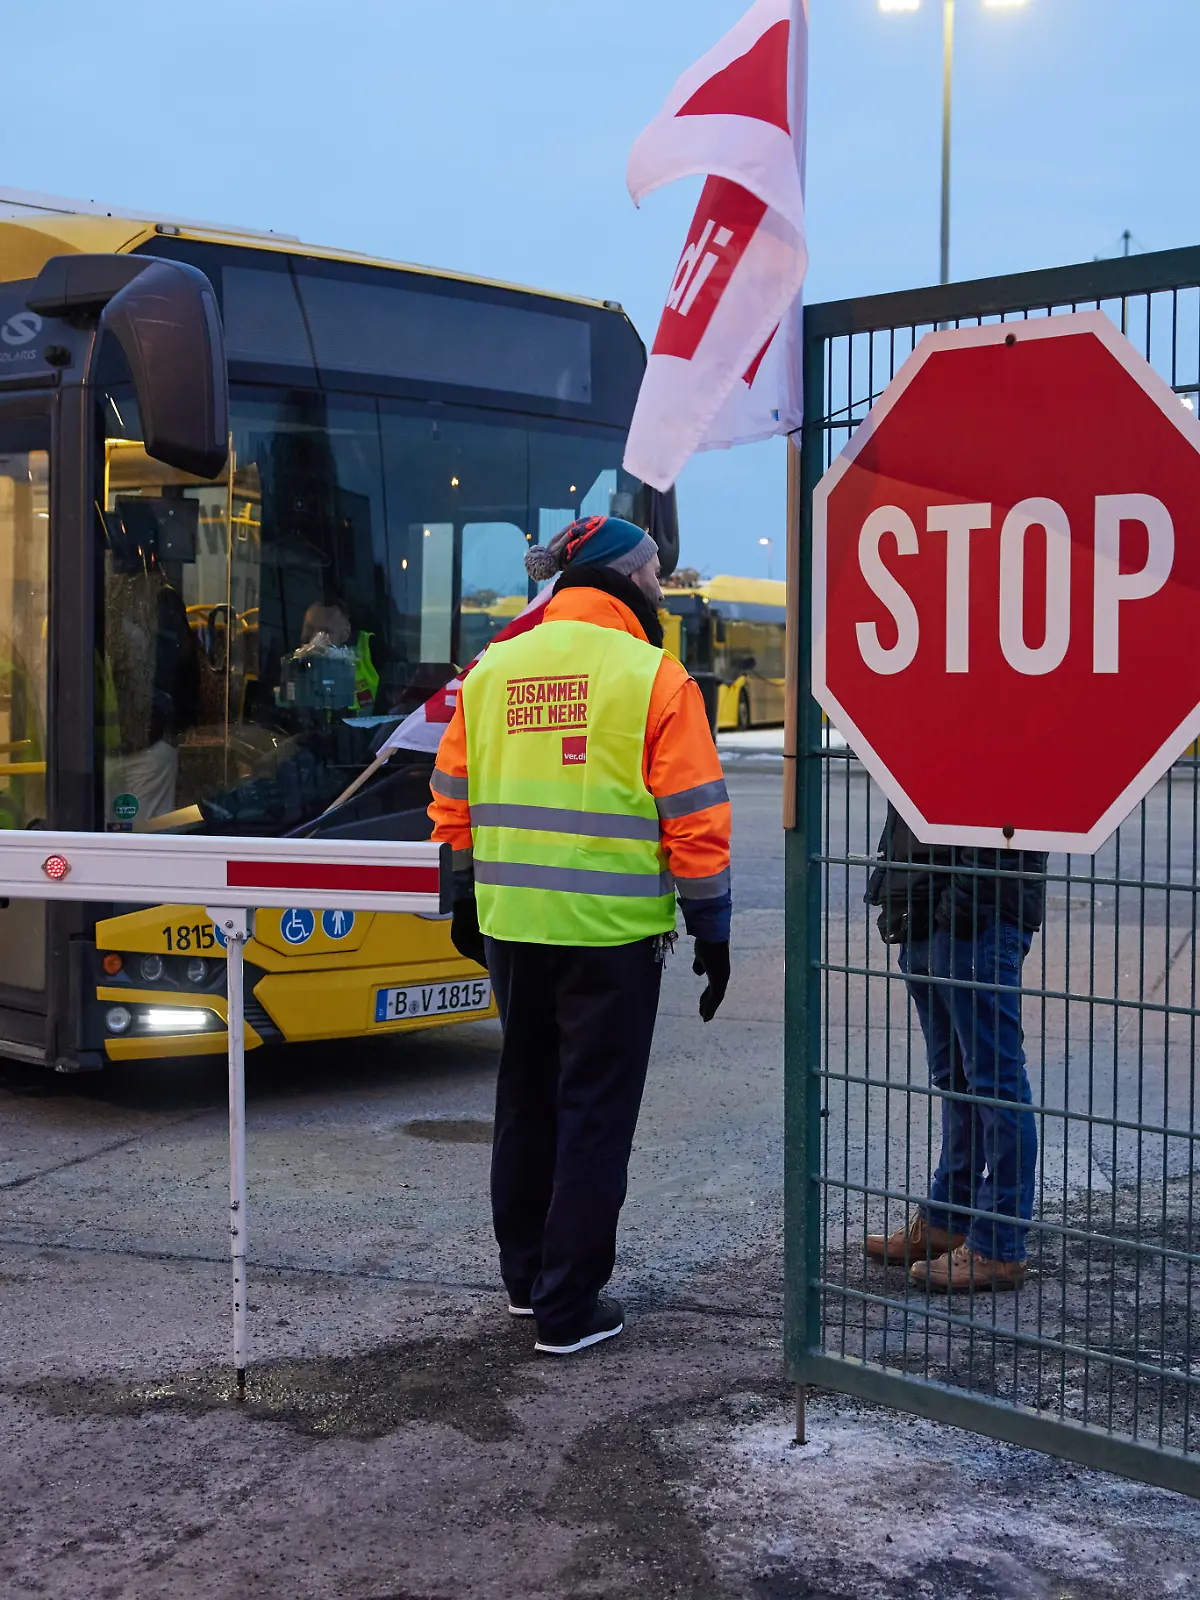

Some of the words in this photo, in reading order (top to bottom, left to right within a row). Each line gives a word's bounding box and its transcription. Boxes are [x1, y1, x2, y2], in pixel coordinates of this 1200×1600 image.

[0, 349, 37, 362] OLARIS
[855, 493, 1175, 676] STOP
[506, 681, 588, 706] ZUSAMMEN
[507, 705, 544, 728] GEHT
[548, 703, 587, 725] MEHR
[563, 752, 587, 761] ver.di
[162, 924, 215, 951] 1815
[395, 991, 408, 1016] B
[421, 988, 434, 1012] V
[437, 983, 484, 1011] 1815
